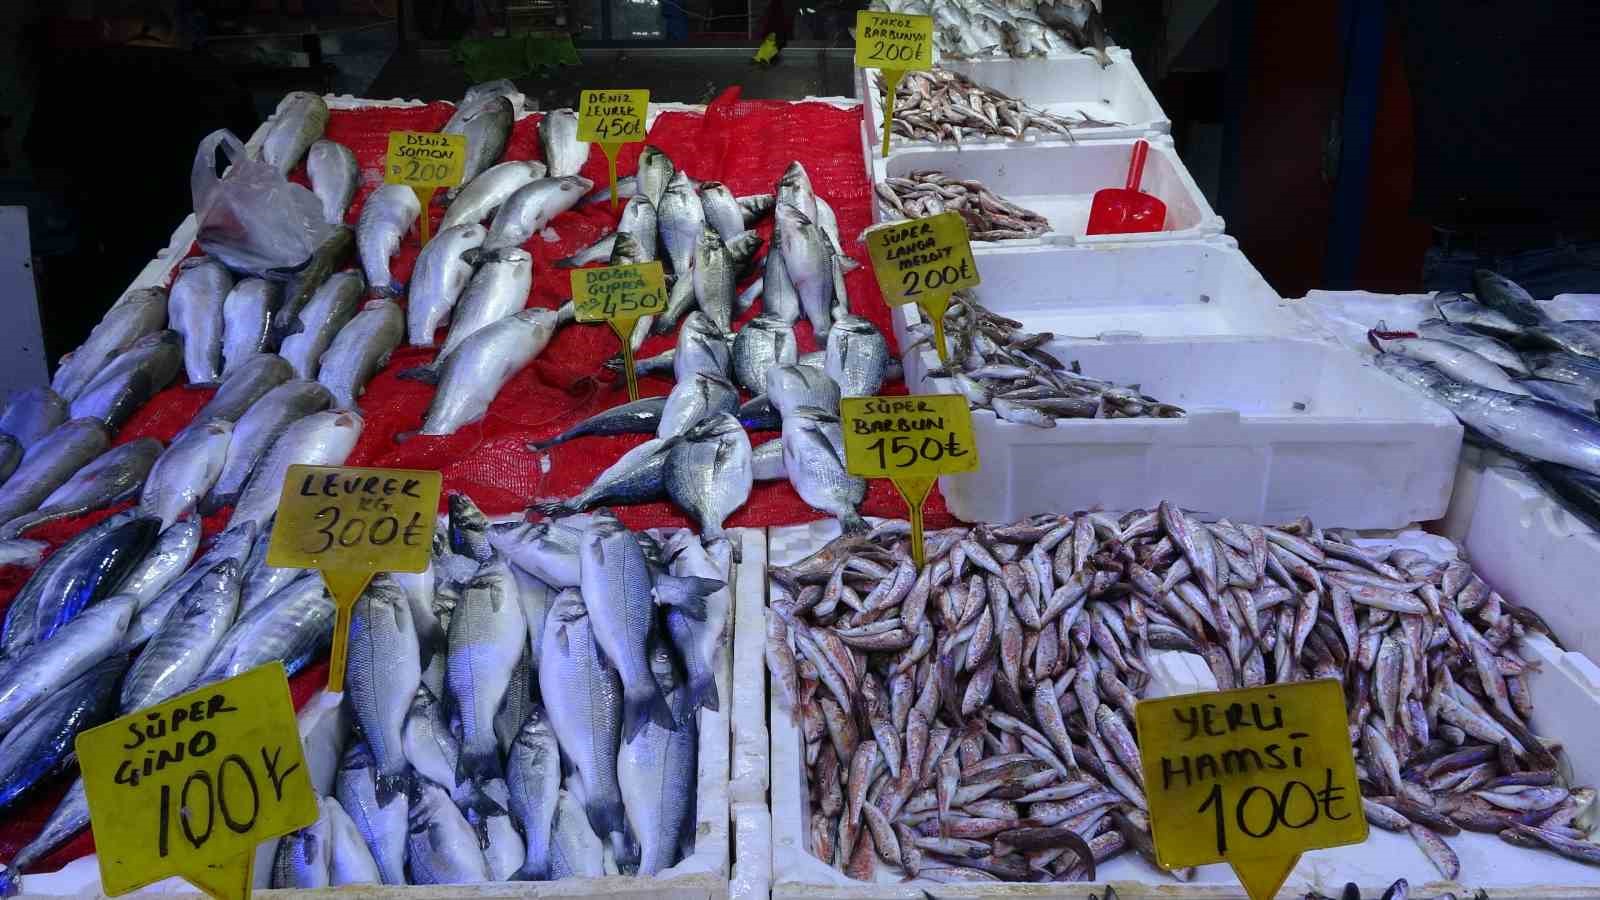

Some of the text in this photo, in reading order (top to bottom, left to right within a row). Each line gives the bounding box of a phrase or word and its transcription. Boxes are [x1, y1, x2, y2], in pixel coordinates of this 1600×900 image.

[394, 145, 454, 159] SOMON
[863, 398, 937, 415] SÜPER
[852, 416, 945, 435] BARBUN
[300, 472, 422, 498] LEVREK
[123, 694, 239, 751] SÜPER
